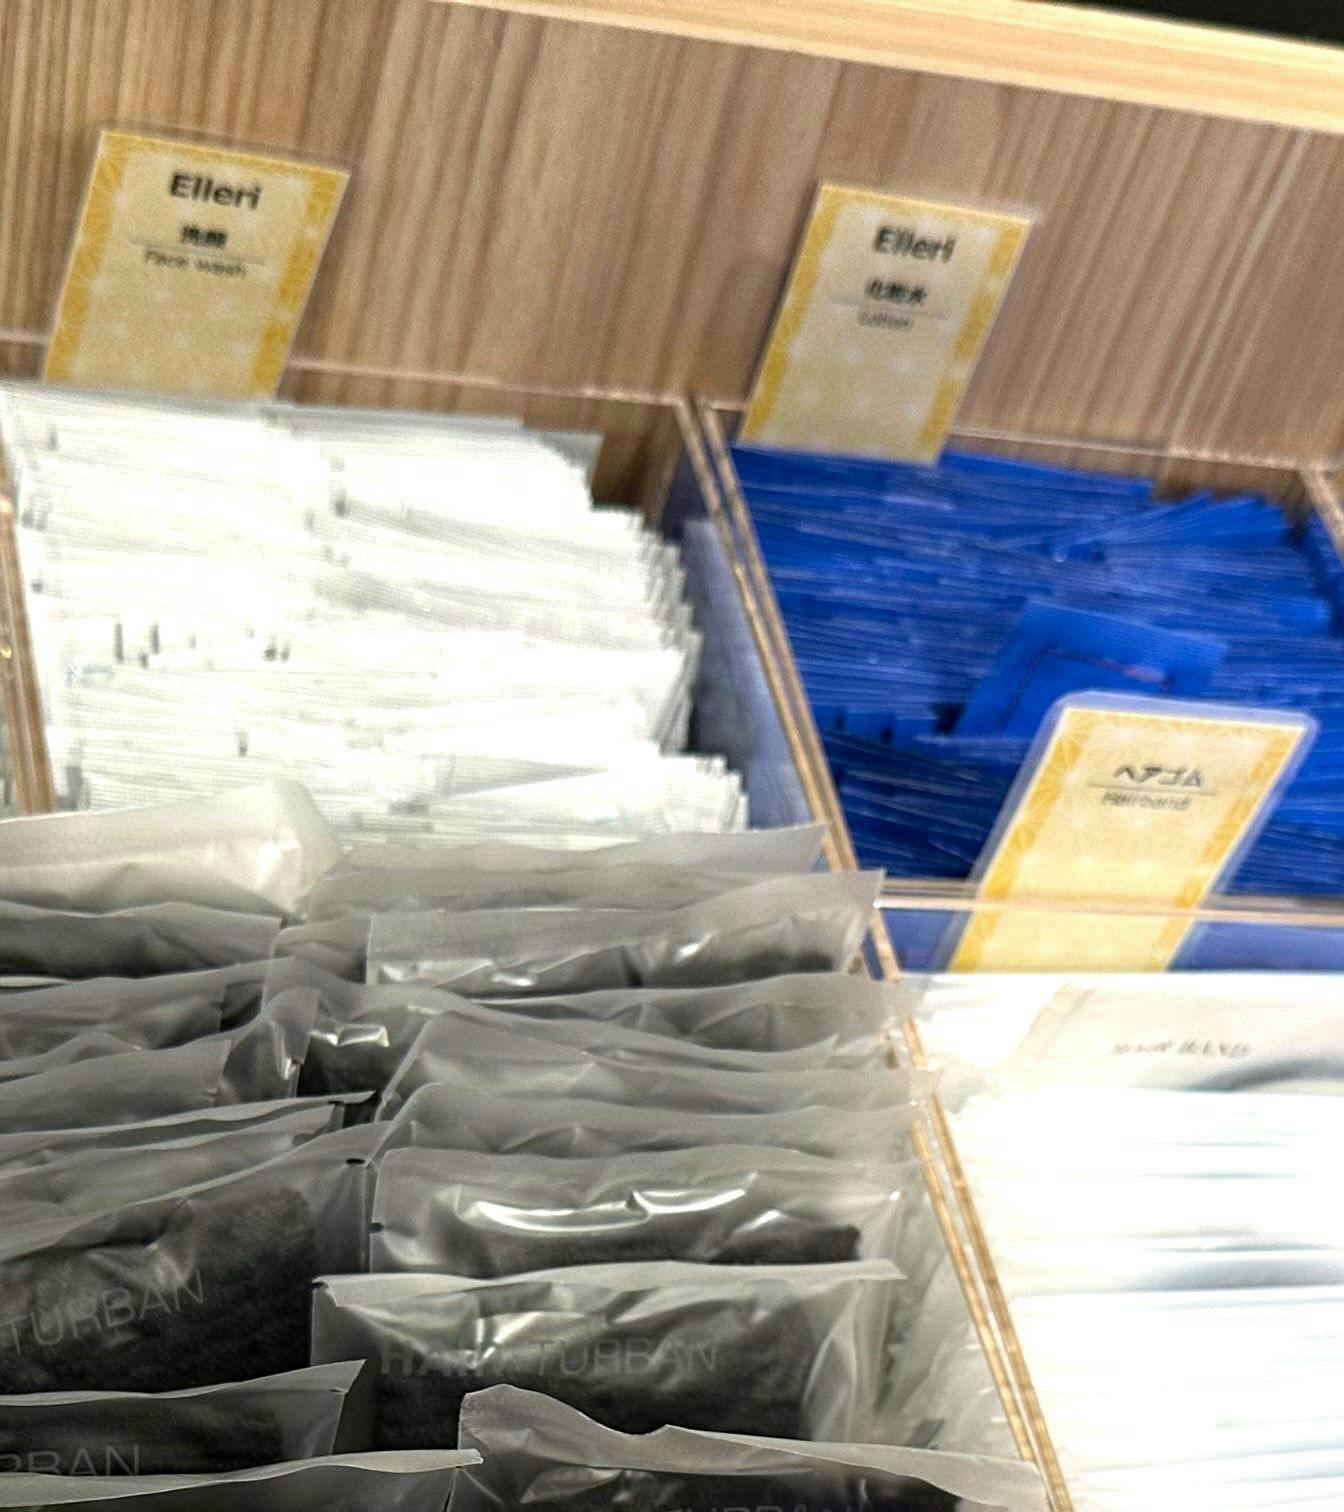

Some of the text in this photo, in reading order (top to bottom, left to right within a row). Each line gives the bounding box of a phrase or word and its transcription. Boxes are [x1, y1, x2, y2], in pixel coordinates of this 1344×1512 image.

[169, 172, 262, 211] Elleri
[873, 225, 956, 264] Elleri
[1111, 764, 1206, 789] ヘアゴム
[2, 1270, 206, 1357] TURBAN
[536, 1336, 720, 1377] TURBAN
